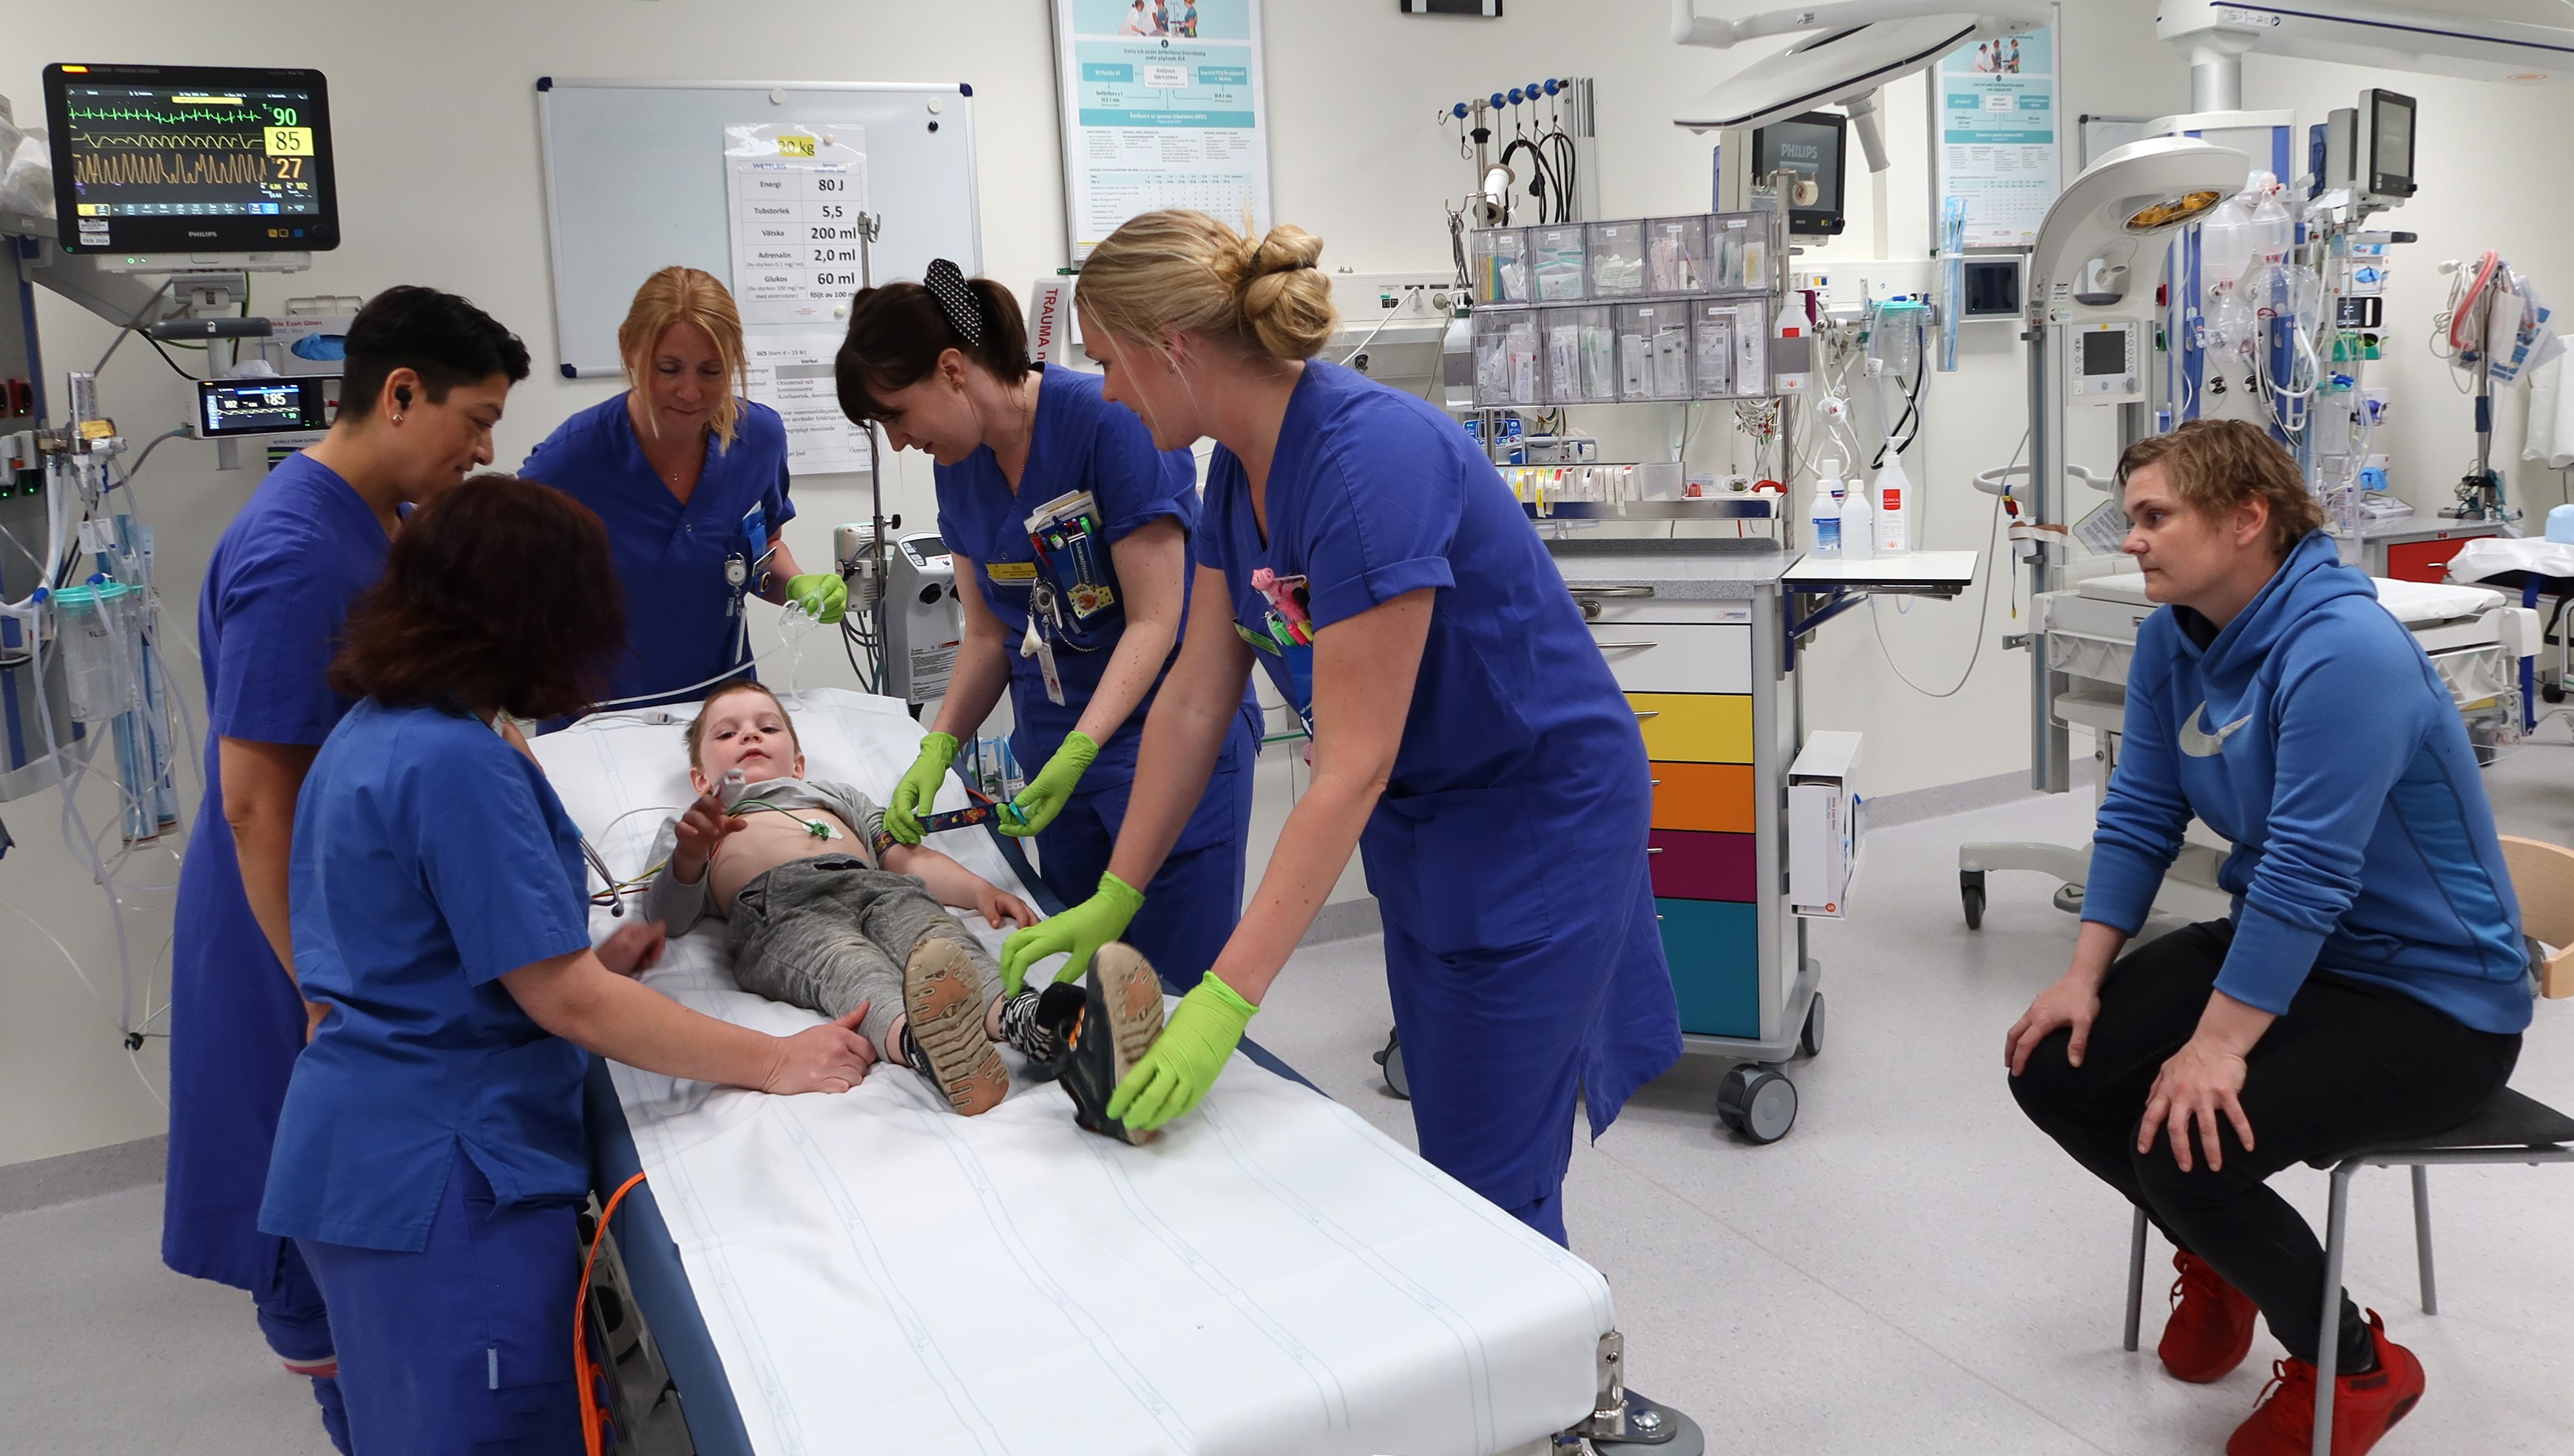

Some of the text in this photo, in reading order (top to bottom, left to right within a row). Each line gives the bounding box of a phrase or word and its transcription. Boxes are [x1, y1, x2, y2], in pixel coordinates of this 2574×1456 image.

[274, 108, 297, 126] 90
[276, 132, 300, 150] 85
[779, 140, 815, 155] 20 kg
[1781, 143, 1818, 159] PHILIPS
[277, 158, 302, 179] 27
[819, 180, 834, 191] 80
[839, 180, 844, 191] J
[754, 206, 843, 220] Tubstorlek 5,5
[762, 227, 856, 240] Vätska 200 ml
[814, 249, 835, 263] 2,0
[839, 248, 855, 260] ml
[818, 274, 834, 284] 60
[839, 272, 854, 284] ml
[1038, 288, 1058, 348] TRAUMA
[270, 393, 285, 405] 85
[1075, 541, 1091, 584] SJUKSKÖTERSKA
